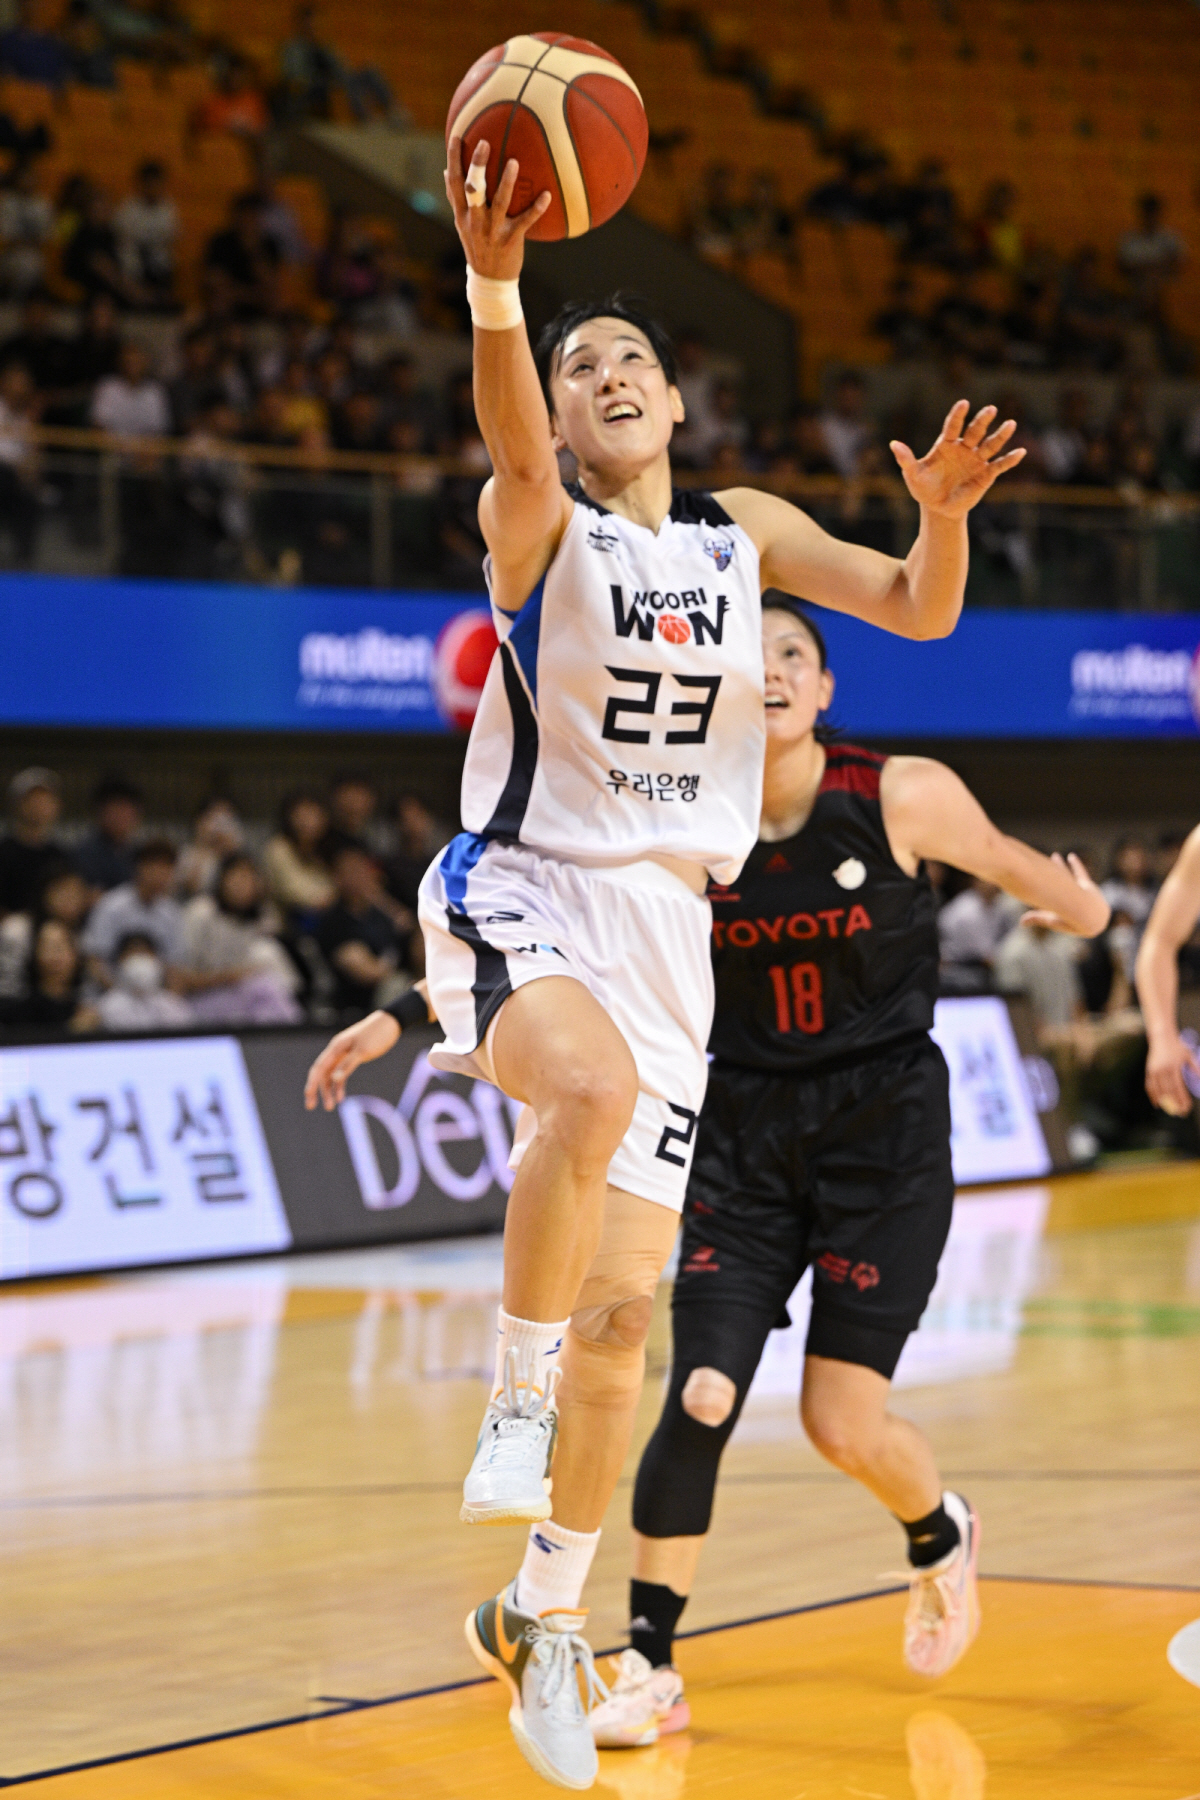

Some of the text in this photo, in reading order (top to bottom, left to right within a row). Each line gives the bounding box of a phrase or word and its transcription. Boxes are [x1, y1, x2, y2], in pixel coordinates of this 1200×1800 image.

[634, 587, 707, 610] WOORI
[602, 664, 723, 745] 23
[606, 769, 700, 802] 우리은행
[711, 903, 873, 949] TOYOTA
[768, 961, 825, 1035] 18
[655, 1100, 699, 1169] 2
